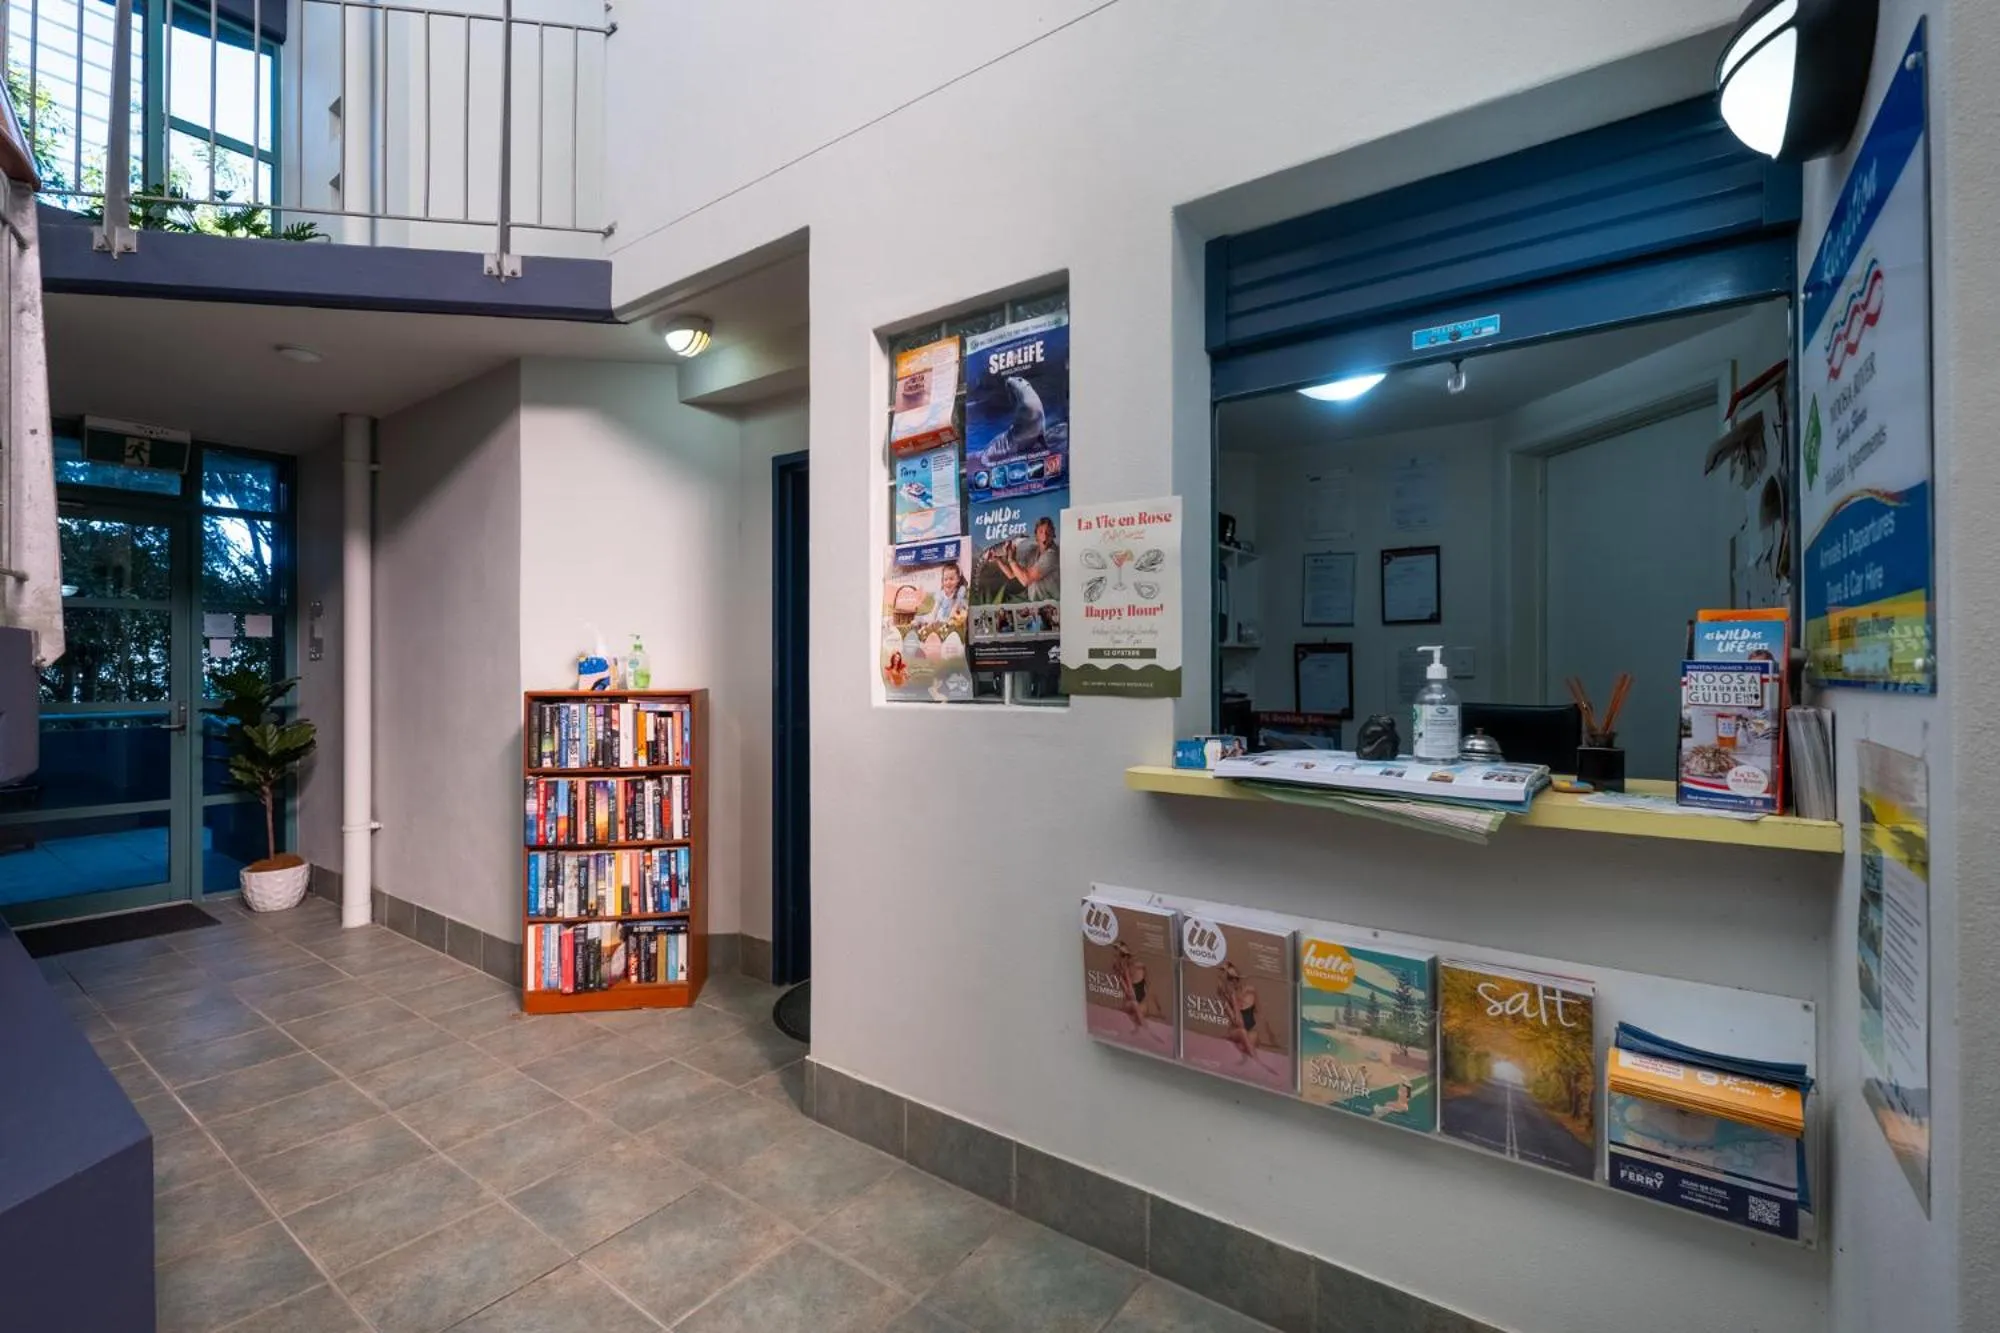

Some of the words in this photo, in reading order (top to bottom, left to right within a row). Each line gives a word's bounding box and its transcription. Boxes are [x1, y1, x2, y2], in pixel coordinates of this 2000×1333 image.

[989, 350, 1015, 374] SEA
[984, 506, 1011, 525] WILD
[1077, 518, 1092, 531] La
[1096, 515, 1116, 528] Vie
[1118, 516, 1135, 526] en
[1138, 512, 1172, 525] Rose
[986, 523, 1008, 540] LIFE
[1009, 523, 1027, 535] GETS
[1849, 510, 1895, 557] Departures
[1850, 570, 1863, 597] Car
[1865, 562, 1883, 592] Hire
[1085, 605, 1123, 620] Happy
[1127, 603, 1164, 616] Hour!
[1715, 628, 1750, 640] WILD
[1751, 631, 1762, 639] AS
[1717, 641, 1746, 653] LIFE
[1688, 673, 1758, 684] NOOSA
[1688, 692, 1744, 704] GUIDE
[1086, 903, 1112, 931] in
[1088, 927, 1111, 938] NOOSA
[1188, 920, 1219, 951] in
[1189, 948, 1217, 960] NOOSA
[1304, 943, 1351, 974] hello
[1088, 970, 1122, 989] SEXY
[1088, 983, 1125, 999] SUMMER
[1188, 994, 1226, 1016] SEXY
[1477, 982, 1582, 1027] salt
[1188, 1009, 1229, 1025] SUMMER
[1311, 1075, 1370, 1099] SUMMER
[1620, 1169, 1664, 1188] FERRY
